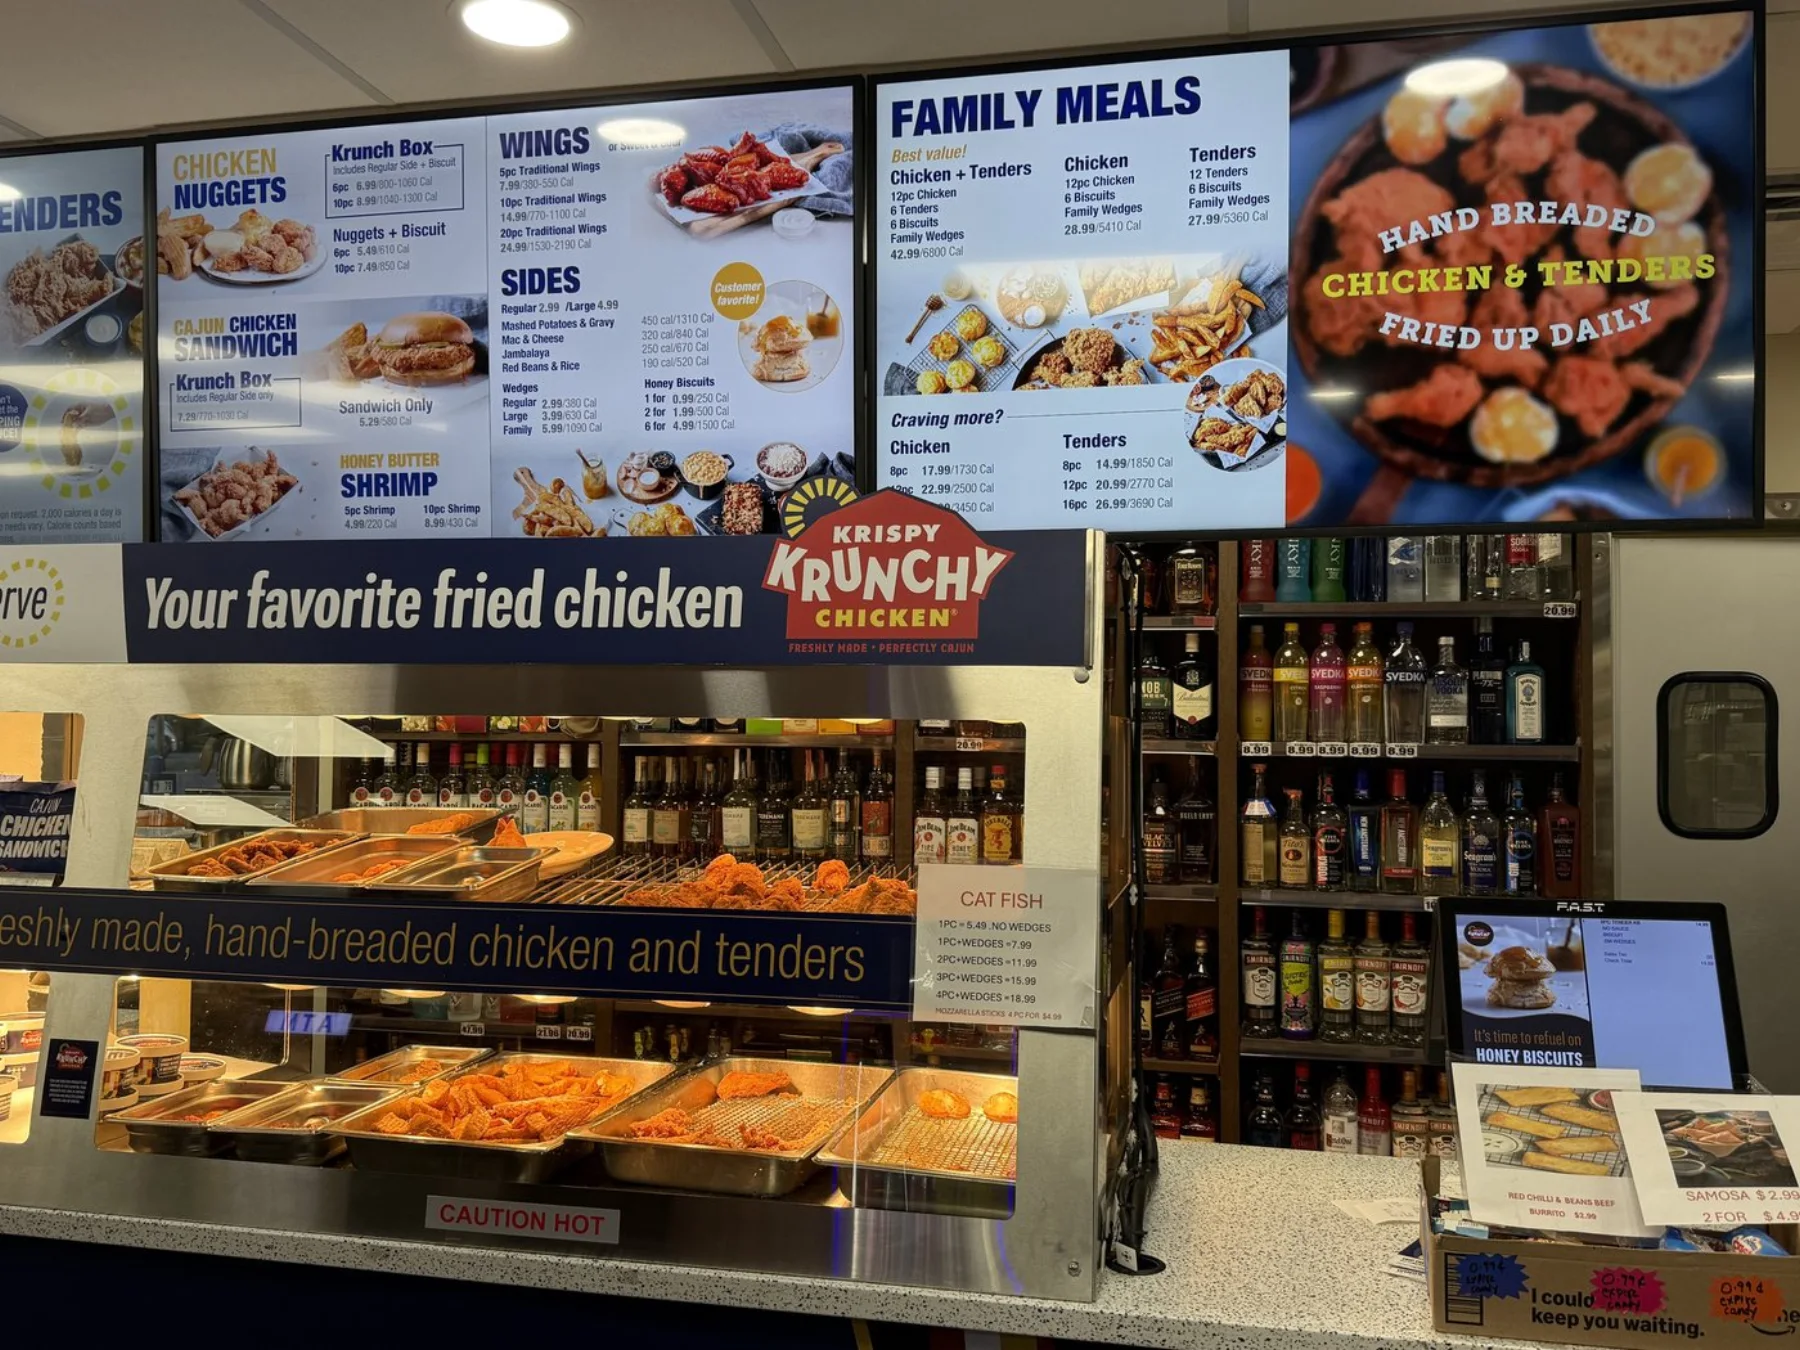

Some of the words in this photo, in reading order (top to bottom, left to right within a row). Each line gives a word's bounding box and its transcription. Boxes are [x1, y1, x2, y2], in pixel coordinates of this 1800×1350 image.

[891, 89, 1043, 138] FAMILY
[1056, 76, 1202, 125] MEALS
[332, 141, 394, 162] Krunch
[400, 139, 434, 156] Box
[499, 126, 590, 160] WINGS
[891, 149, 921, 163] Best
[926, 144, 967, 161] value!
[1189, 145, 1257, 163] Tenders
[173, 148, 277, 181] CHICKEN
[500, 167, 516, 178] 5pc
[519, 163, 569, 176] Traditional
[571, 161, 601, 173] Wings
[1064, 155, 1128, 172] Chicken
[890, 168, 951, 185] Chicken
[956, 170, 966, 181] +
[969, 162, 1032, 180] Tenders
[174, 176, 287, 210] NUGGETS
[891, 191, 913, 203] 12pc
[917, 188, 957, 200] Chicken
[890, 205, 897, 216] 6
[900, 203, 939, 215] Tenders
[890, 219, 897, 230] 6
[900, 217, 939, 229] Biscuits
[1377, 207, 1481, 254] HAND
[1491, 200, 1657, 238] BREADED
[333, 226, 385, 245] Nuggets
[389, 229, 397, 239] +
[402, 222, 446, 238] Biscuit
[890, 233, 923, 244] Family
[925, 230, 965, 242] Wedges
[501, 266, 581, 296] SIDES
[1322, 264, 1493, 298] CHICKEN
[1503, 262, 1527, 288] &
[1537, 254, 1717, 288] TENDERS
[714, 282, 762, 293] Customer
[717, 295, 760, 306] favorite!
[174, 318, 225, 336] CAJUN
[229, 313, 297, 333] CHICKEN
[501, 320, 536, 331] Mashed
[538, 318, 578, 330] Potatoes
[579, 319, 587, 328] &
[589, 317, 615, 329] Gravy
[1378, 311, 1482, 351] FRIED
[1492, 327, 1540, 352] UP
[1548, 299, 1653, 348] DAILY
[174, 332, 297, 362] SANDWICH
[502, 335, 520, 345] Mac
[523, 334, 529, 343] &
[532, 333, 564, 344] Cheese
[502, 348, 550, 360] Jambalaya
[502, 363, 519, 373] Red
[521, 362, 549, 372] Beans
[551, 361, 558, 371] &
[560, 360, 580, 371] Rice
[176, 372, 235, 392] Krunch
[240, 371, 273, 389] Box
[502, 383, 538, 395] Wedges
[644, 378, 674, 390] Honey
[676, 376, 715, 388] Biscuits
[339, 399, 401, 414] Sandwich
[405, 398, 433, 414] Only
[891, 411, 950, 429] Craving
[954, 408, 1004, 425] more?
[890, 439, 951, 455] Chicken
[1063, 433, 1127, 449] Tenders
[340, 454, 384, 469] HONEY
[388, 452, 440, 468] BUTTER
[341, 472, 438, 499] SHRIMP
[833, 524, 941, 543] KRISPY
[767, 543, 1008, 602] KRUNCHY
[145, 577, 238, 630] Your
[246, 569, 422, 630] favorite
[433, 567, 545, 629] fried
[554, 566, 743, 630] chicken
[815, 608, 950, 628] CHICKEN
[1545, 607, 1575, 616] 20.99
[788, 643, 834, 653] FRESHLY
[837, 643, 868, 653] MADE
[879, 643, 936, 653] PERFECTLY
[940, 643, 974, 653] CAJUN
[1386, 671, 1426, 682] SVEDKA
[1243, 746, 1269, 754] 8.99
[1288, 746, 1314, 755] 8.99
[1319, 747, 1345, 756] 8.99
[1351, 746, 1379, 755] 8.99
[1387, 747, 1415, 756] 8.99
[30, 798, 62, 814] CAJUN
[960, 891, 996, 908] CAT
[1001, 892, 1043, 909] FISH
[939, 920, 957, 929] 1PC
[967, 921, 987, 931] 5.49
[1009, 923, 1051, 932] WEDGES
[92, 912, 192, 961] made,
[205, 913, 457, 966] hand-breaded
[468, 922, 615, 970] chicken
[629, 930, 700, 974] and
[716, 932, 865, 982] tenders
[938, 937, 1004, 948] 1PC+WEDGES
[937, 955, 1004, 966] 2PC+WEDGES
[936, 973, 1003, 984] 3PC+WEDGES
[936, 991, 1003, 1002] 4PC+WEDGES
[1474, 1029, 1491, 1042] It's
[1493, 1030, 1519, 1044] time
[1520, 1032, 1532, 1044] to
[1534, 1031, 1566, 1046] refuel
[1568, 1036, 1581, 1046] on
[1476, 1047, 1519, 1063] HONEY
[1523, 1048, 1583, 1067] BISCUITS
[1508, 1192, 1526, 1201] RED
[1526, 1193, 1555, 1203] CHILLI
[1555, 1195, 1562, 1204] &
[1564, 1196, 1594, 1207] BEANS
[1594, 1198, 1616, 1208] BEEF
[1686, 1190, 1750, 1201] SAMOSA
[440, 1204, 546, 1231] CAUTION
[554, 1213, 605, 1235] HOT
[1529, 1208, 1566, 1218] BURRITO
[1574, 1211, 1597, 1221] $2.99
[1703, 1211, 1711, 1222] 2
[1714, 1211, 1747, 1223] FOR
[1532, 1288, 1537, 1304] I
[1541, 1290, 1595, 1309] could
[1531, 1310, 1579, 1330] keep
[1584, 1314, 1619, 1331] you
[1623, 1316, 1705, 1339] waiting.
